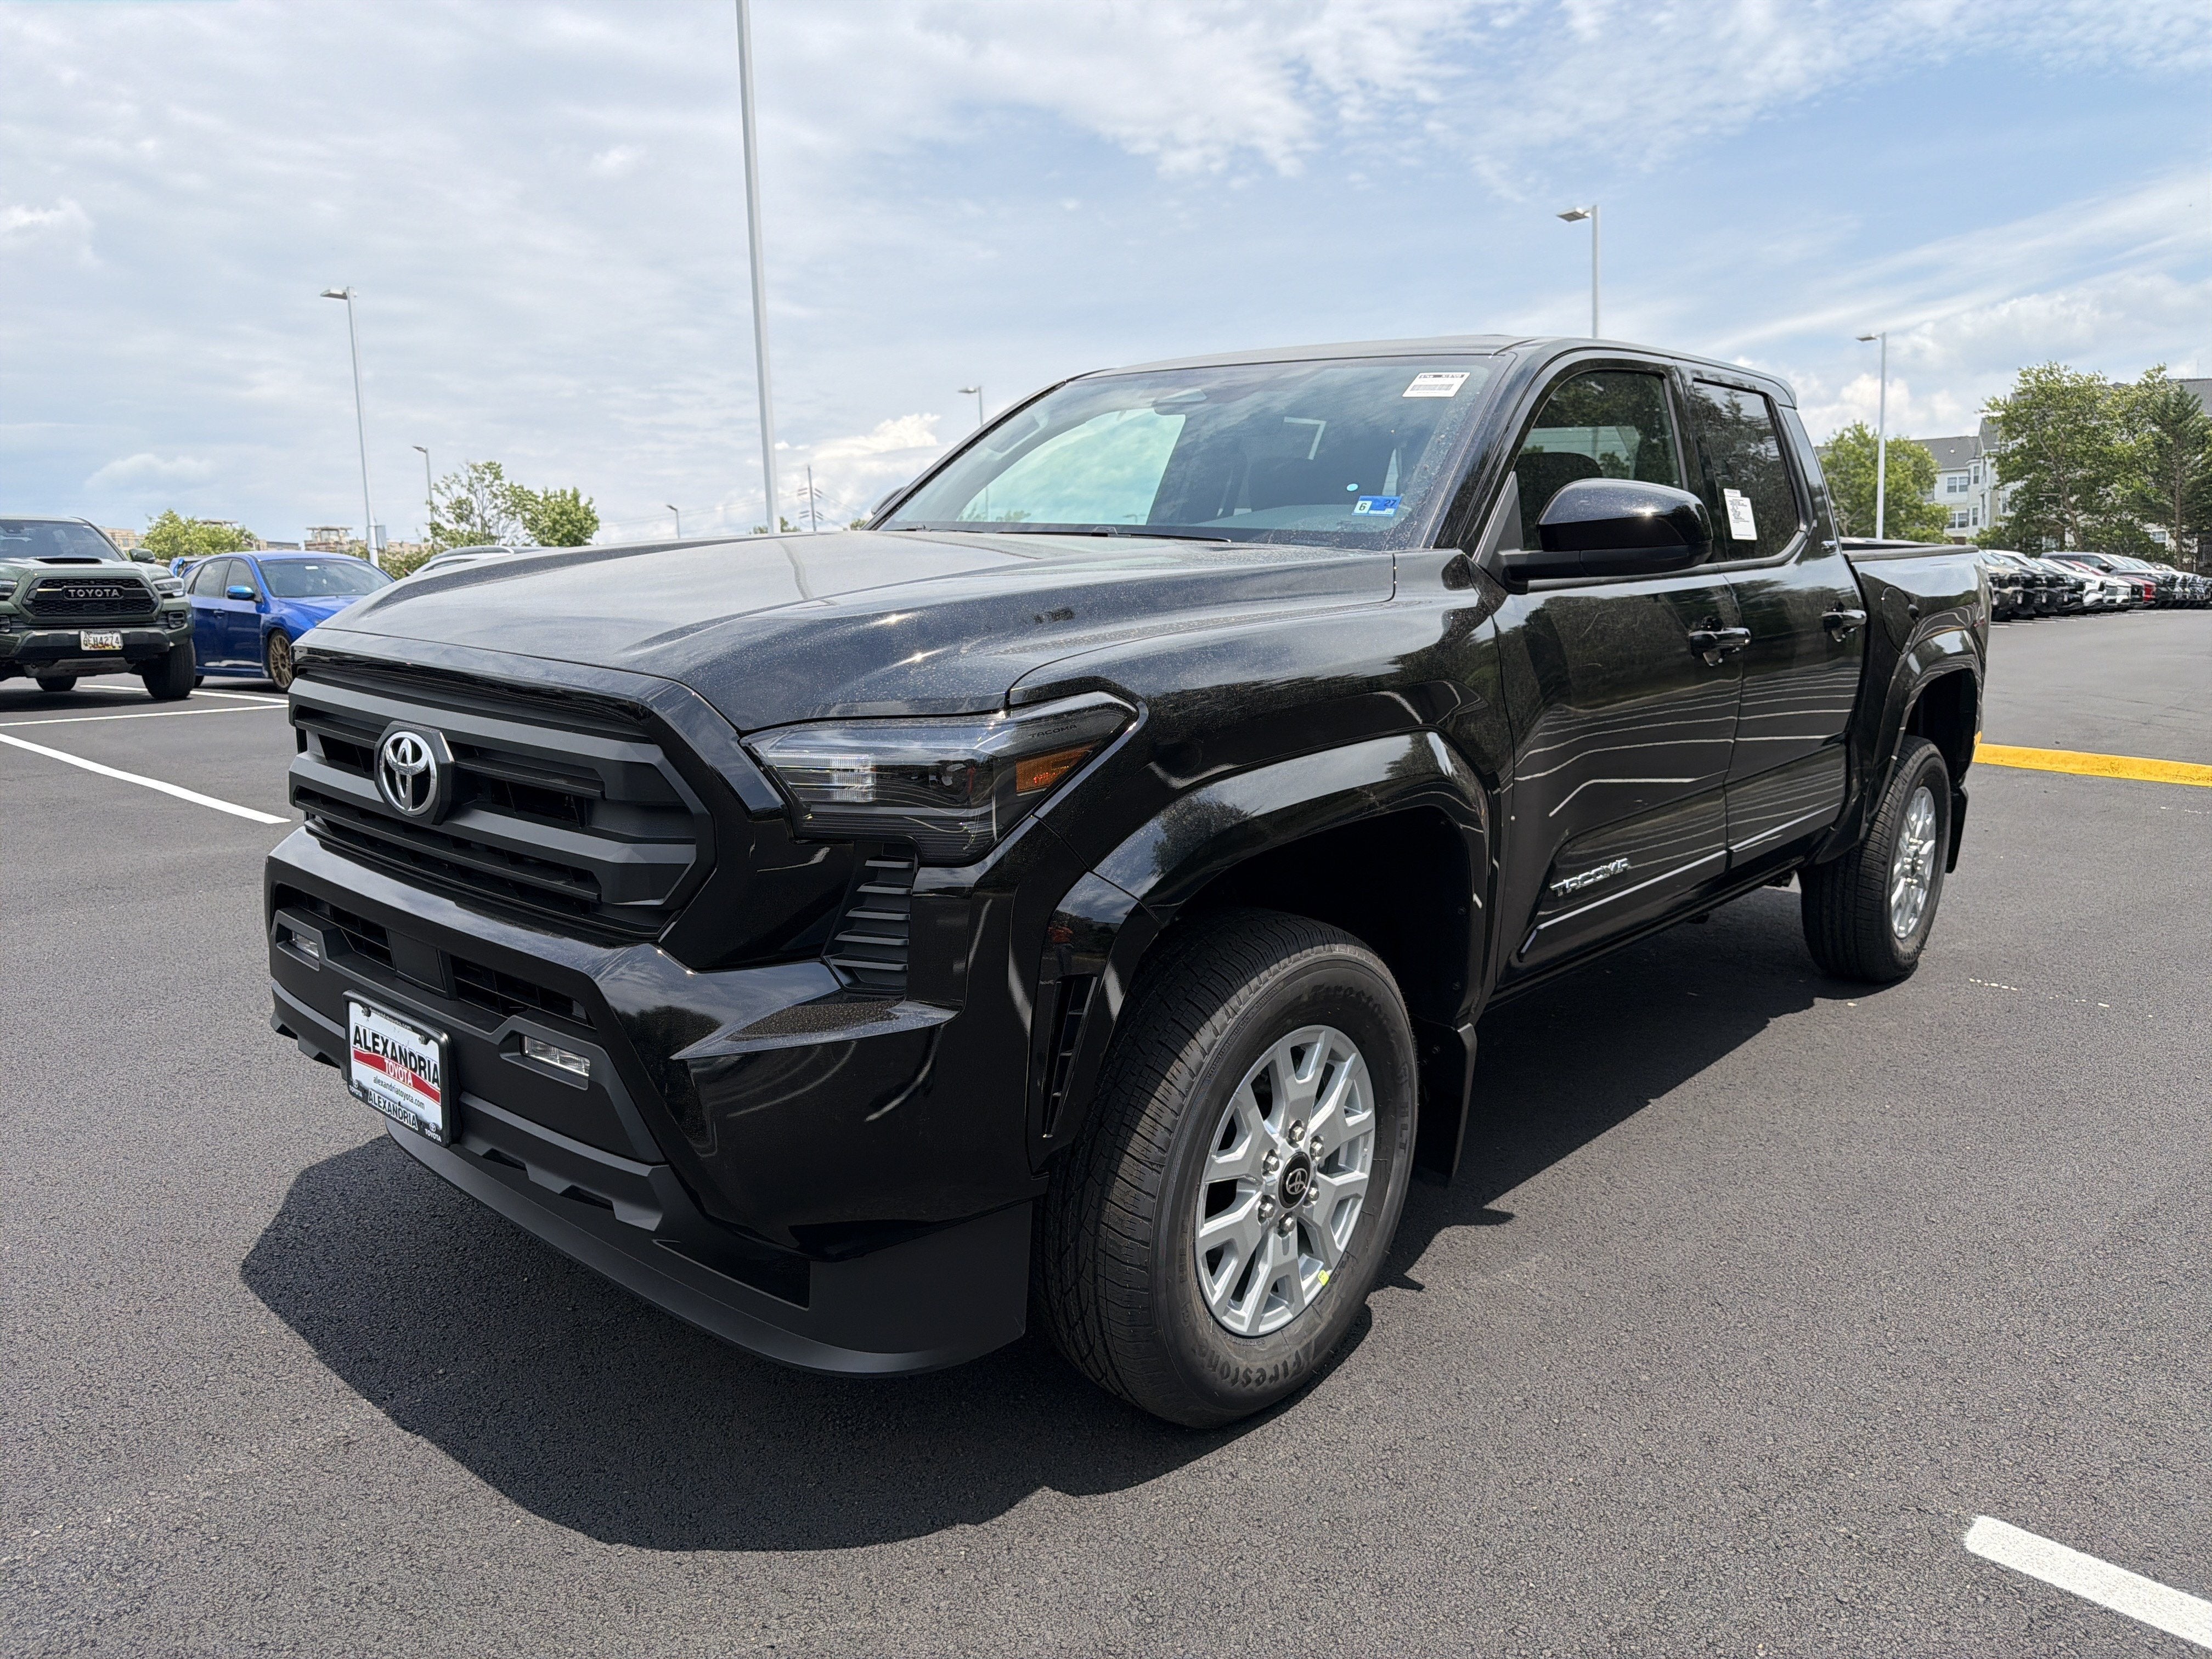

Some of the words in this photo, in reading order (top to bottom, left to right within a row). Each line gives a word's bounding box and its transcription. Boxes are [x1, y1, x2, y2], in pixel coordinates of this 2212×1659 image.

[1358, 502, 1367, 511] 6
[68, 589, 120, 597] TOYOTA
[1028, 724, 1077, 738] TACOMA
[1550, 857, 1632, 897] TACOMA
[353, 1024, 441, 1088] ALEXANDRIA
[384, 1059, 413, 1087] TOYOTA
[349, 1084, 363, 1098] TOYOTA
[373, 1075, 425, 1110] alexandriatoyota.com
[368, 1090, 419, 1131] ALEXANDRIA
[425, 1128, 442, 1142] TOYOTA
[1191, 1345, 1305, 1388] Firestone
